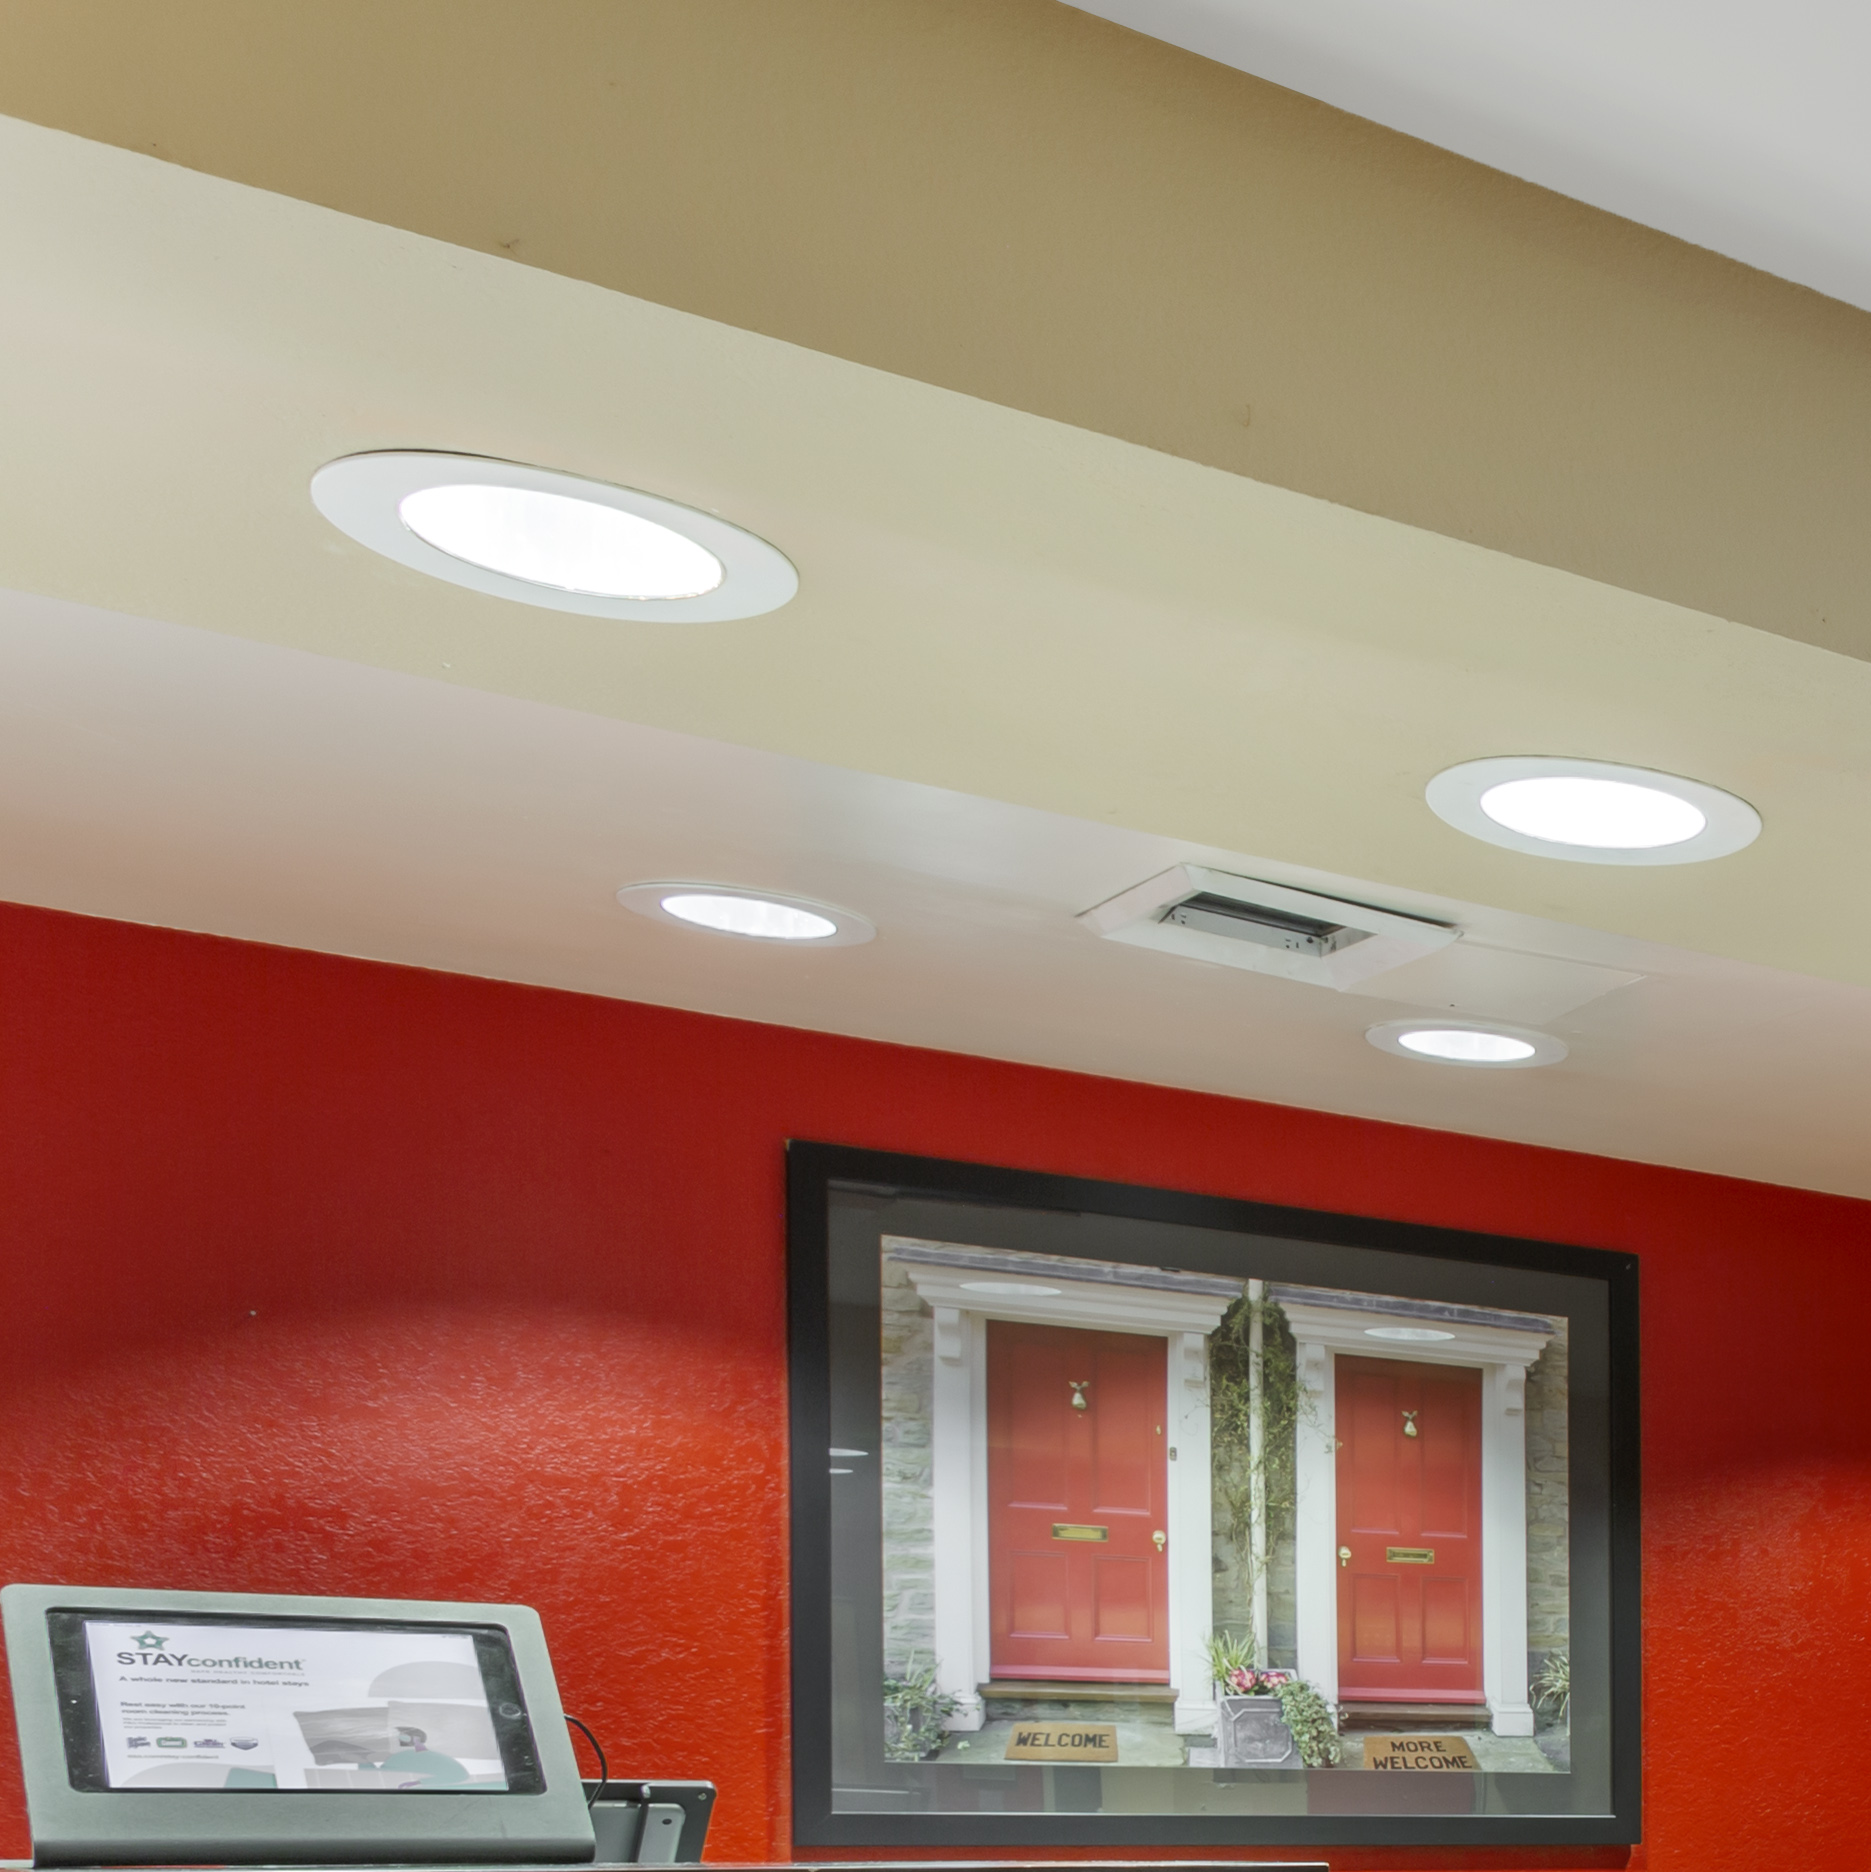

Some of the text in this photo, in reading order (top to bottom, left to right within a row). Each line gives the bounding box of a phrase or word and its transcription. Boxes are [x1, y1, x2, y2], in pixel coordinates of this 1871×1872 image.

[116, 1651, 304, 1671] STAYconfident
[1015, 1732, 1110, 1749] WELCOME
[1390, 1741, 1447, 1753] MORE
[1373, 1756, 1473, 1770] WELCOME
